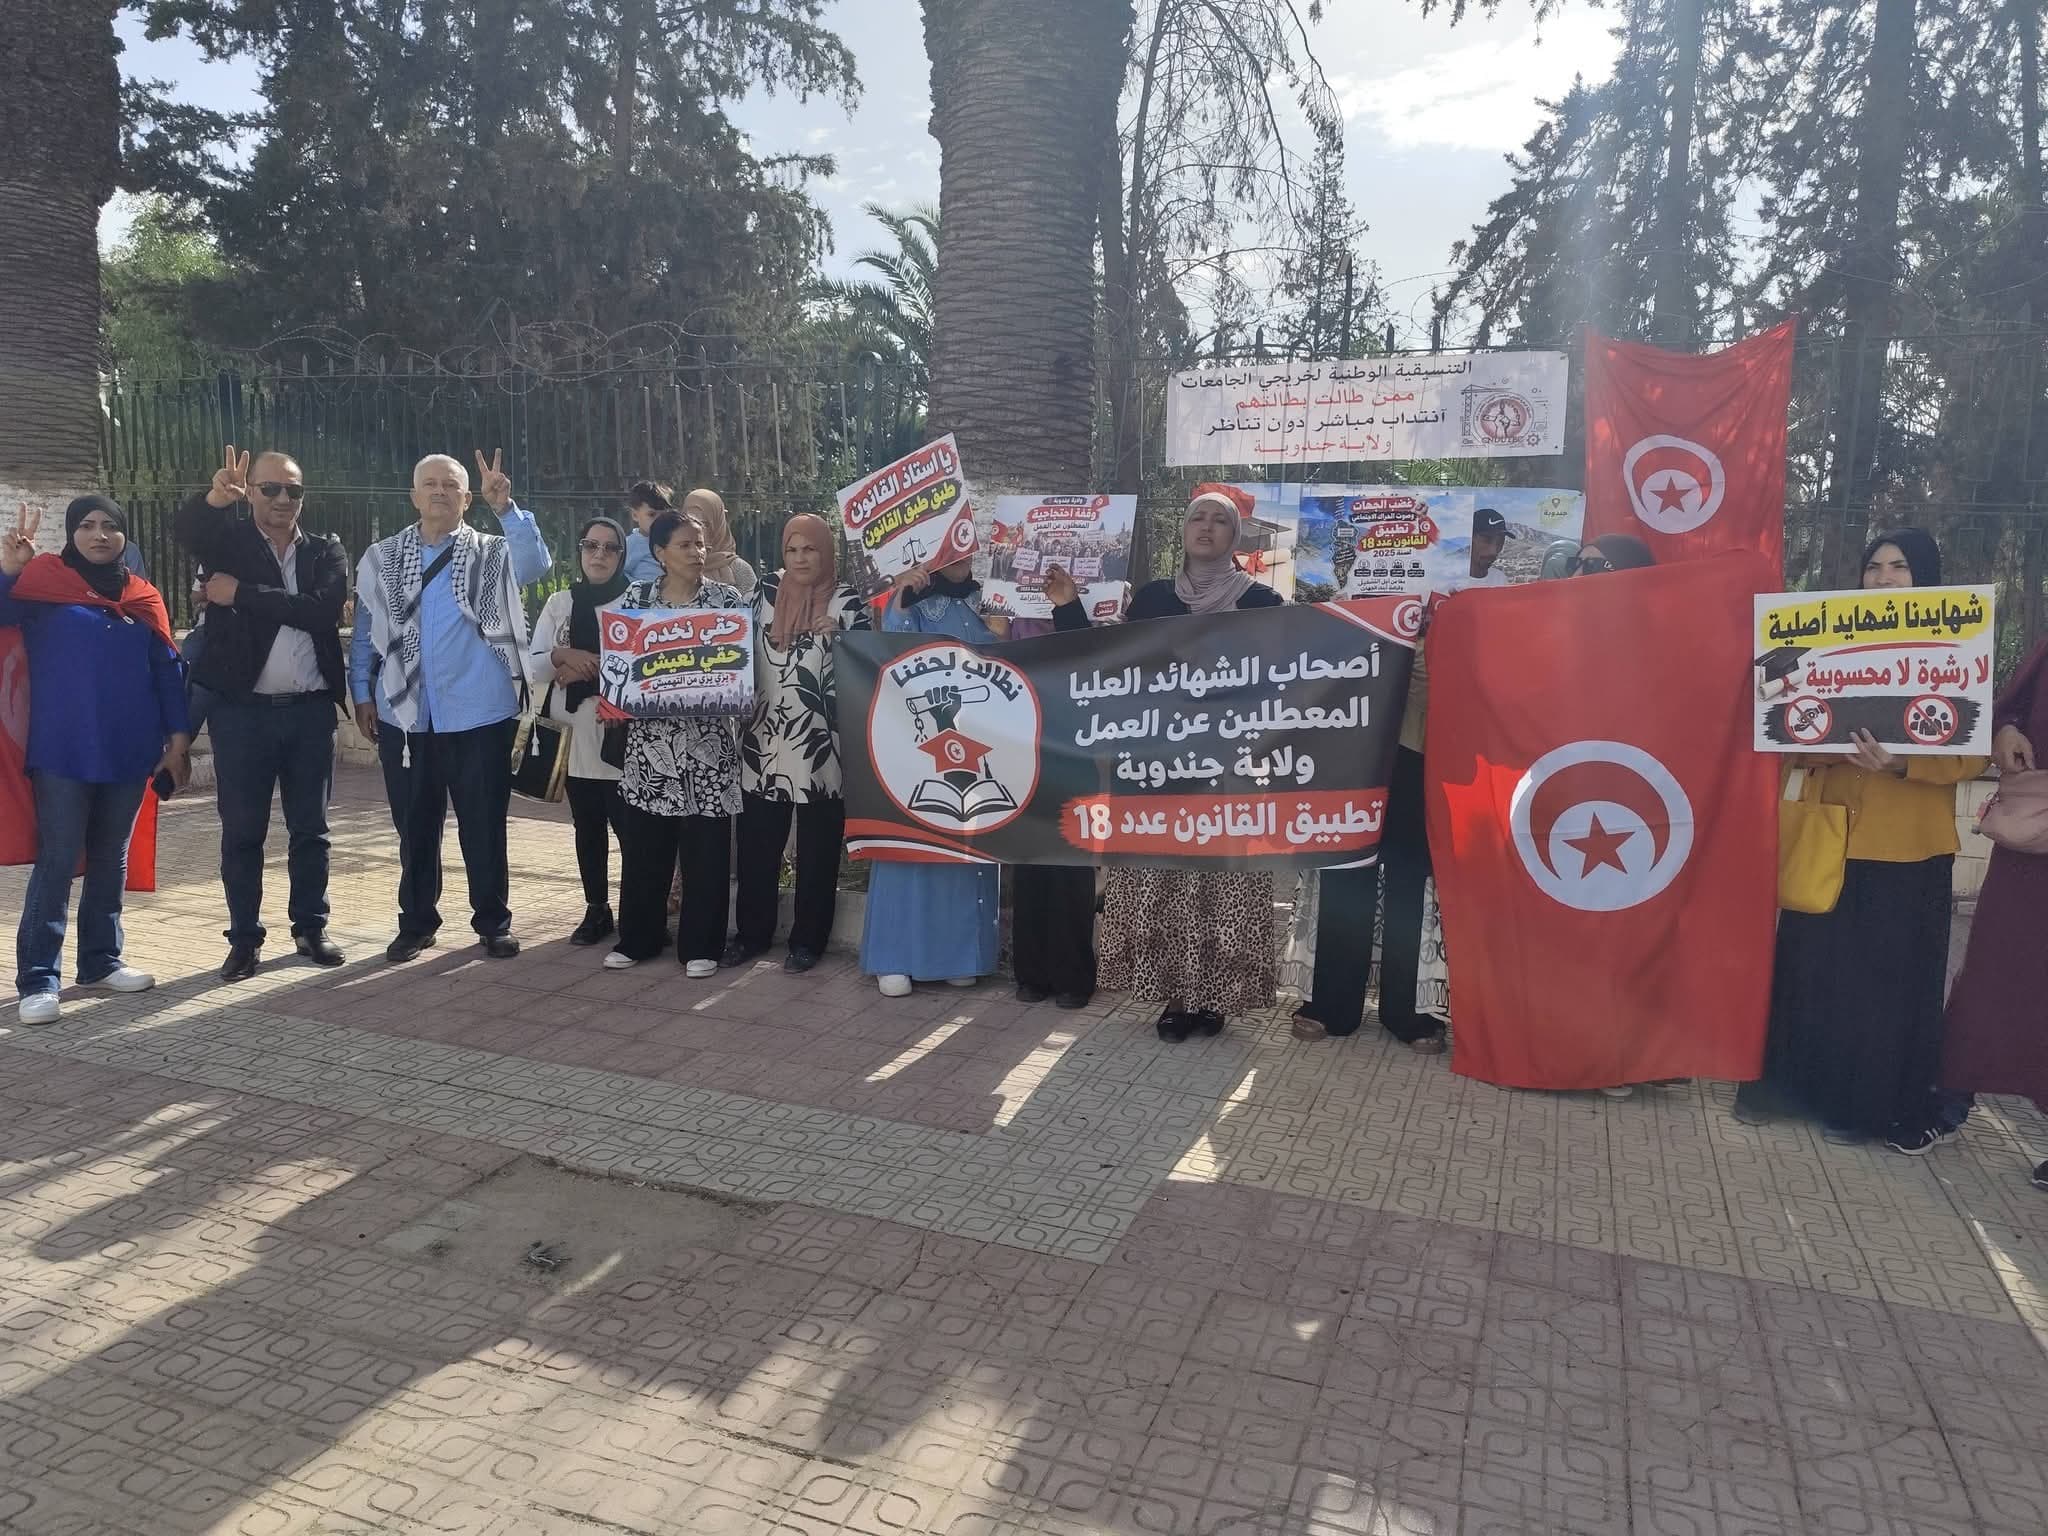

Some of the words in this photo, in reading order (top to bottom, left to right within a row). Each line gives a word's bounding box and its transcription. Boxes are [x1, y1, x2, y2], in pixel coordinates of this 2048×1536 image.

[1181, 373, 1251, 390] الجامعات
[1259, 368, 1321, 391] لخريجي
[1328, 364, 1388, 385] الوطنية
[1395, 360, 1472, 382] التنسيقية
[1235, 390, 1307, 414] بطالتهم
[1314, 387, 1364, 406] طالت
[1371, 391, 1414, 407] ممن
[1204, 417, 1261, 436] تناظر
[1268, 417, 1305, 433] دون
[1313, 413, 1375, 432] مباشر
[938, 447, 953, 474] يا
[851, 471, 901, 524] القانون
[903, 495, 929, 525] طبق
[930, 481, 956, 511] طبق
[1352, 499, 1387, 512] الجهات
[1388, 498, 1414, 512] غضب
[864, 507, 903, 548] القانون
[1031, 507, 1074, 521] احتجاجية
[1033, 522, 1052, 532] العمل
[1075, 508, 1097, 521] وقفة
[1361, 537, 1375, 549] 18
[1375, 523, 1410, 538] تطبيق
[1376, 539, 1393, 547] عدد
[1393, 535, 1428, 548] القانون
[1372, 549, 1396, 558] 2025
[1769, 601, 1828, 646] أصلية
[1832, 600, 1899, 640] شهايد
[1904, 593, 1983, 634] شهايدنا
[643, 620, 695, 651] نخدم
[699, 616, 741, 645] حقي
[641, 648, 695, 677] نعيش
[700, 646, 742, 673] حقي
[1267, 642, 1381, 691] أصحاب
[1897, 654, 1911, 686] لا
[1917, 654, 1970, 692] رشوة
[1974, 654, 1990, 684] لا
[652, 675, 686, 690] التهميش
[686, 676, 697, 685] من
[961, 659, 1023, 702] نطالب
[1069, 666, 1142, 706] العليا
[1147, 655, 1261, 698] الشهائد
[1805, 661, 1892, 694] محسوبية
[1074, 708, 1160, 747] العمل
[1166, 709, 1211, 742] عن
[1217, 694, 1370, 741] المعطلين
[1115, 751, 1225, 789] جندوبة
[1233, 744, 1316, 787] ولاية
[1072, 803, 1113, 841] 18
[1119, 810, 1168, 836] عدد
[1173, 801, 1277, 845] القانون
[1285, 799, 1384, 845] تطبيق
